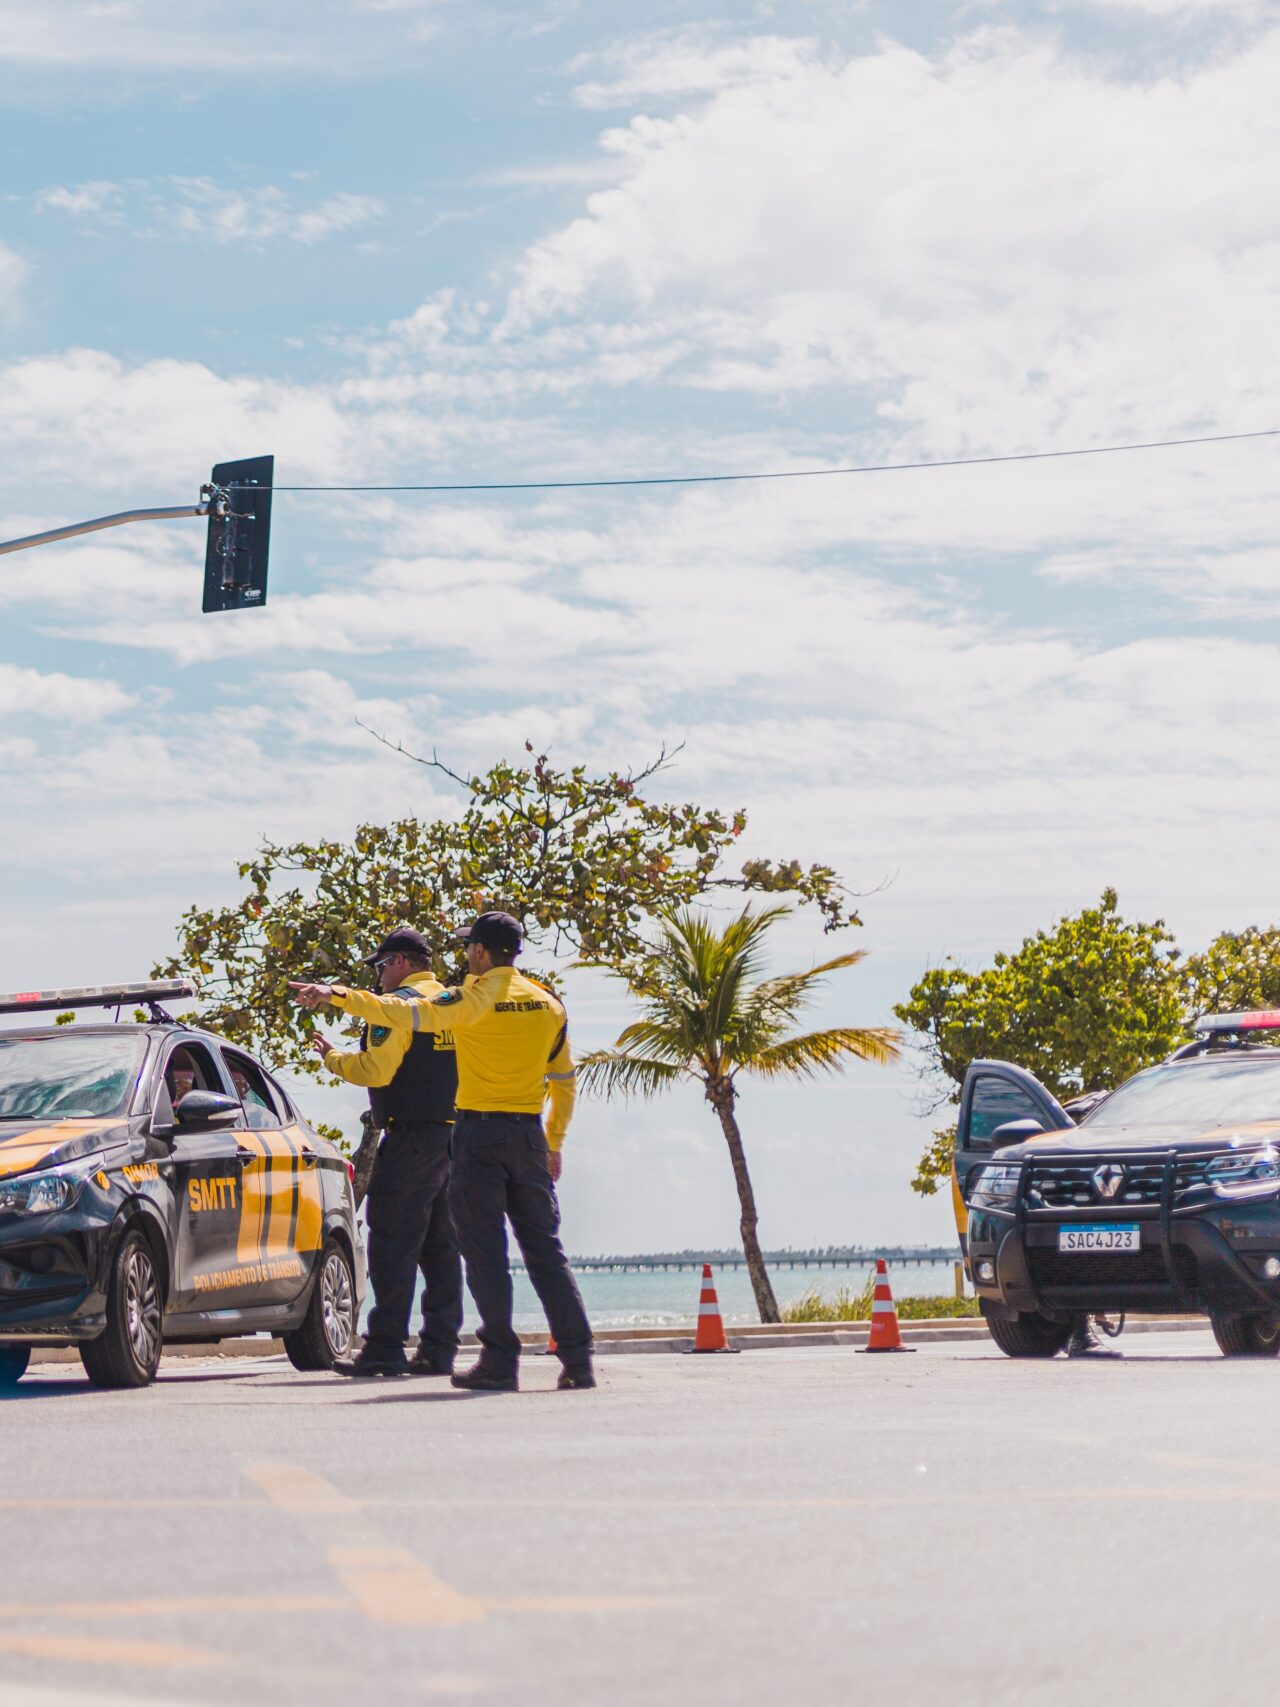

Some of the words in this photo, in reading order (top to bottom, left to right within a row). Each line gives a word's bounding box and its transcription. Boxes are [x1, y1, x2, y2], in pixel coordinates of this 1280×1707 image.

[495, 1001, 516, 1012] AGENTE
[188, 1177, 236, 1212] SMTT
[1068, 1232, 1132, 1248] SAC4J23
[193, 1266, 256, 1294] POLICIAMENTO
[257, 1264, 268, 1282] DE
[268, 1257, 301, 1280] TRÂNSITO
